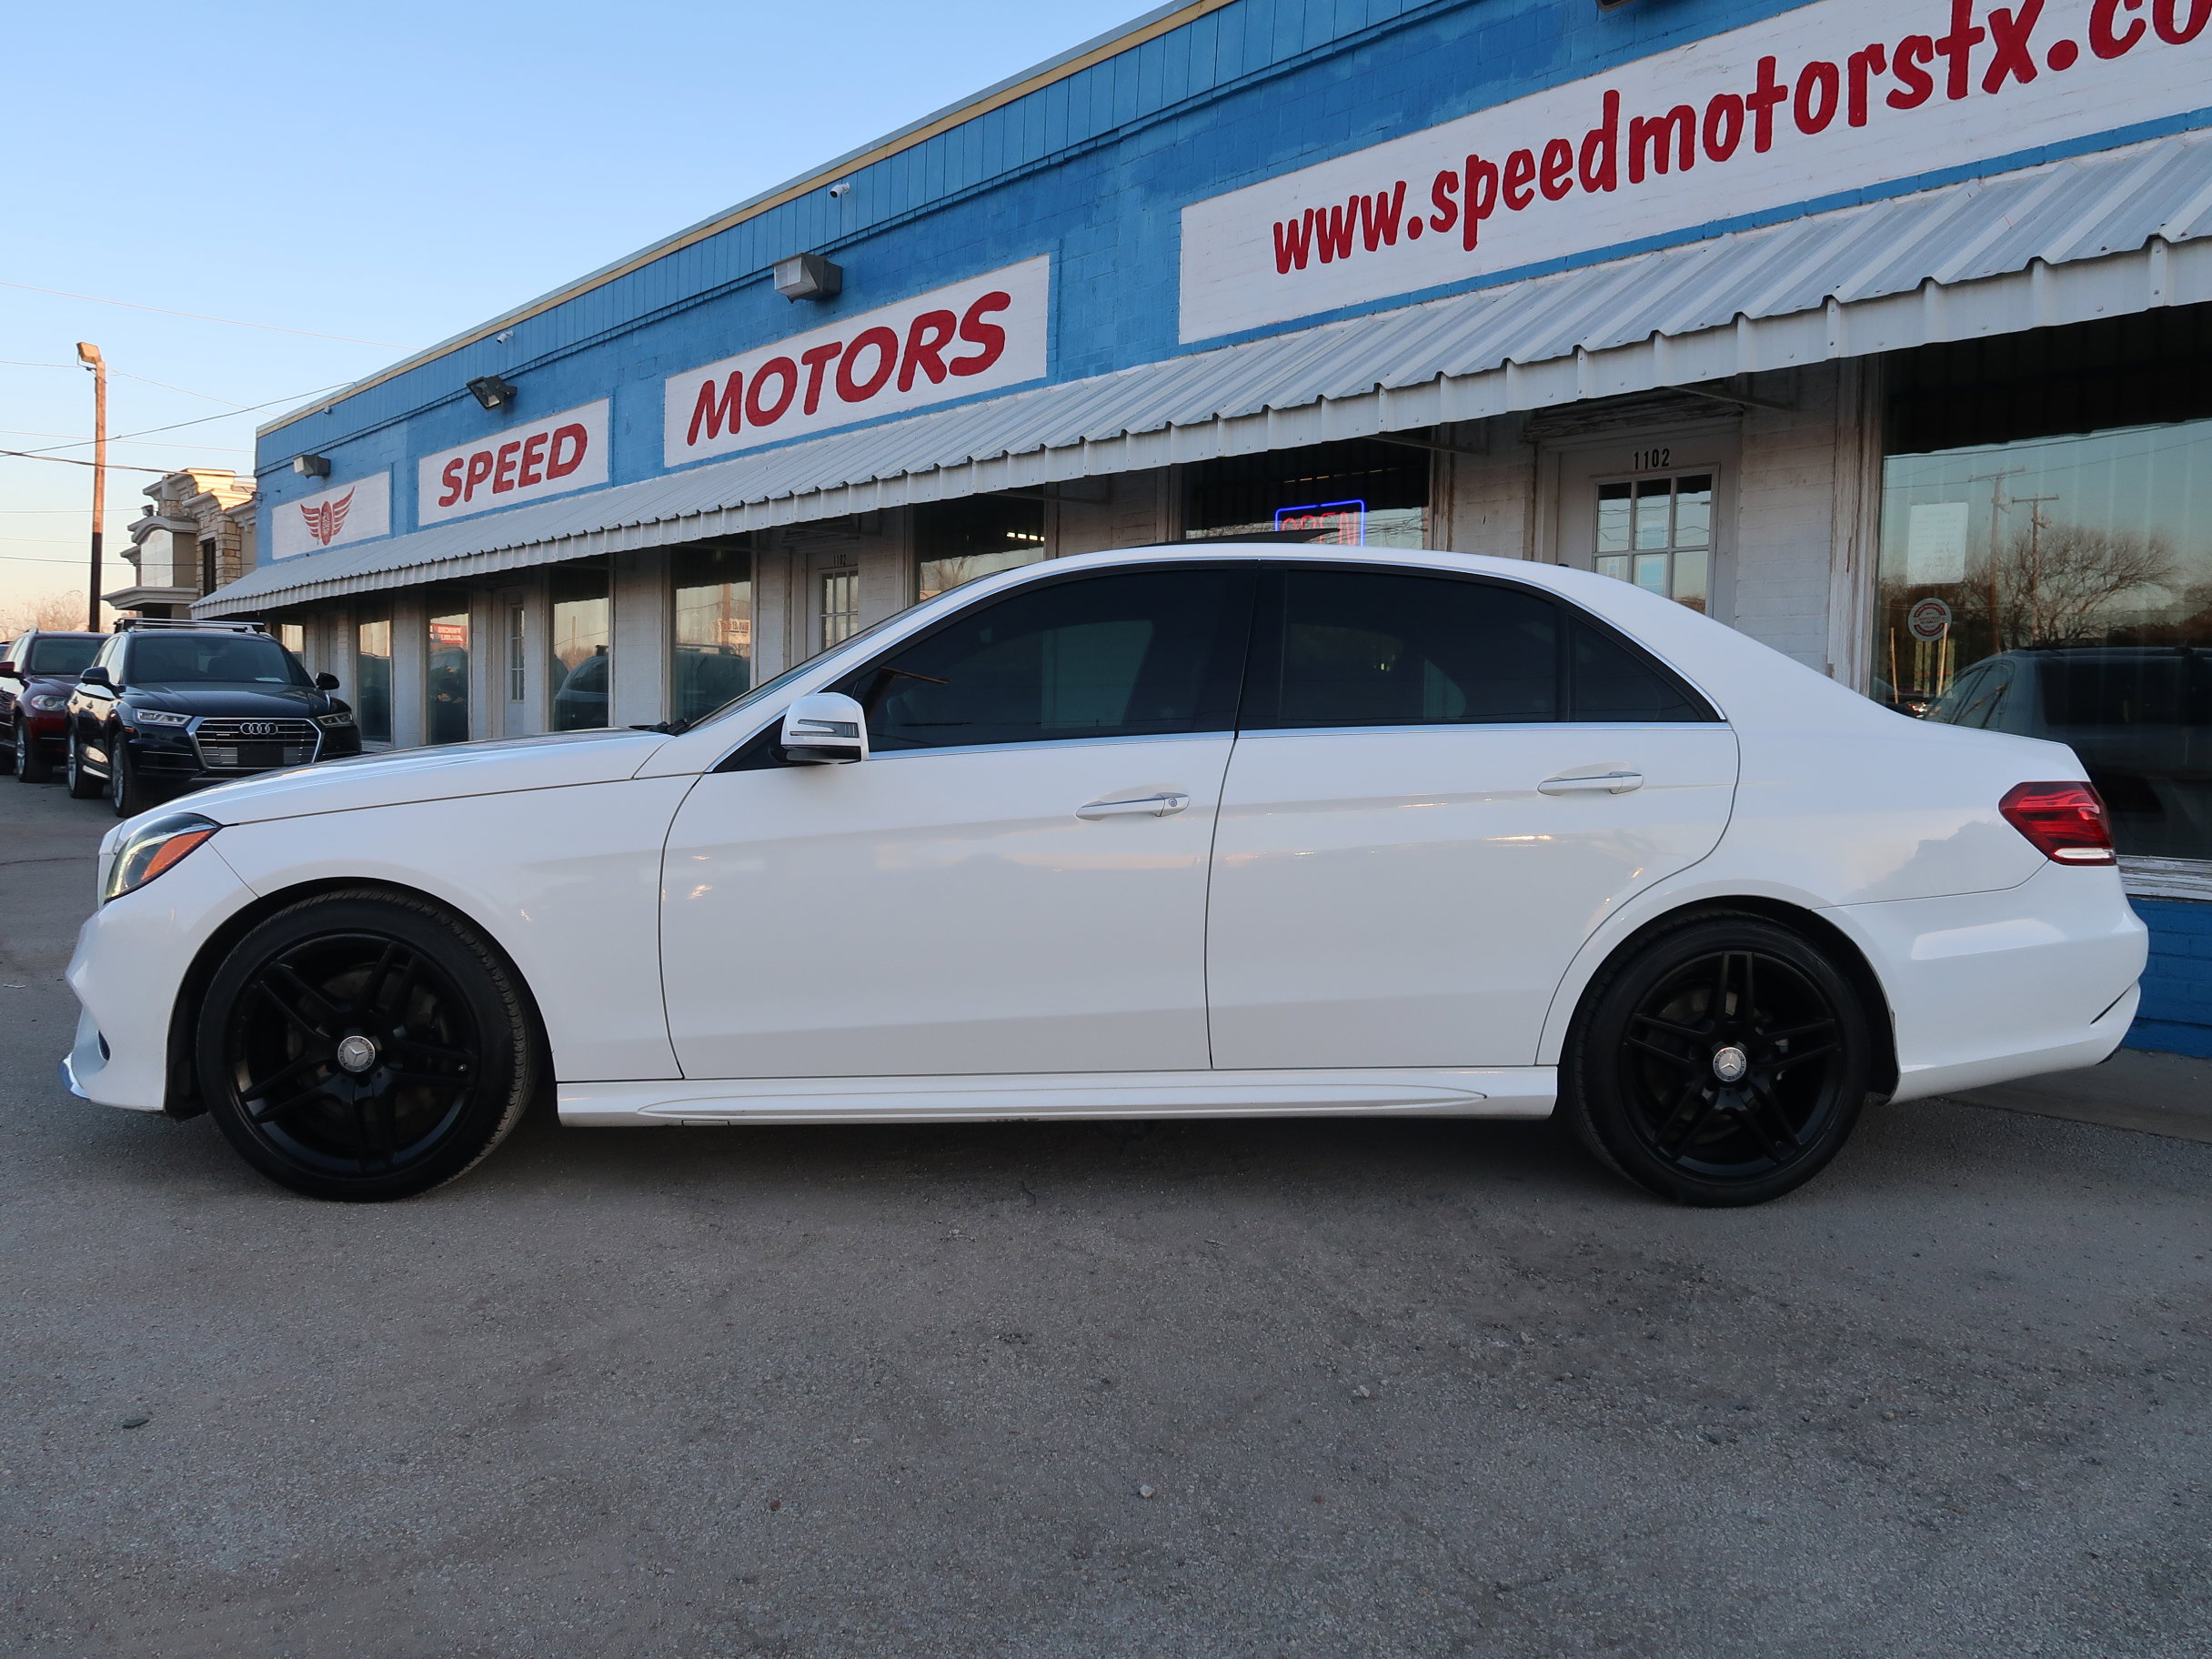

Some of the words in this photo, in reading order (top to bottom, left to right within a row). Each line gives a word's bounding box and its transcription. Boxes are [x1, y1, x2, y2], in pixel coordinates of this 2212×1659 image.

[1273, 0, 2212, 275] www.speedmotorstx.co
[687, 291, 1011, 446] MOTORS
[439, 423, 588, 507] SPEED
[1634, 447, 1670, 470] 1102
